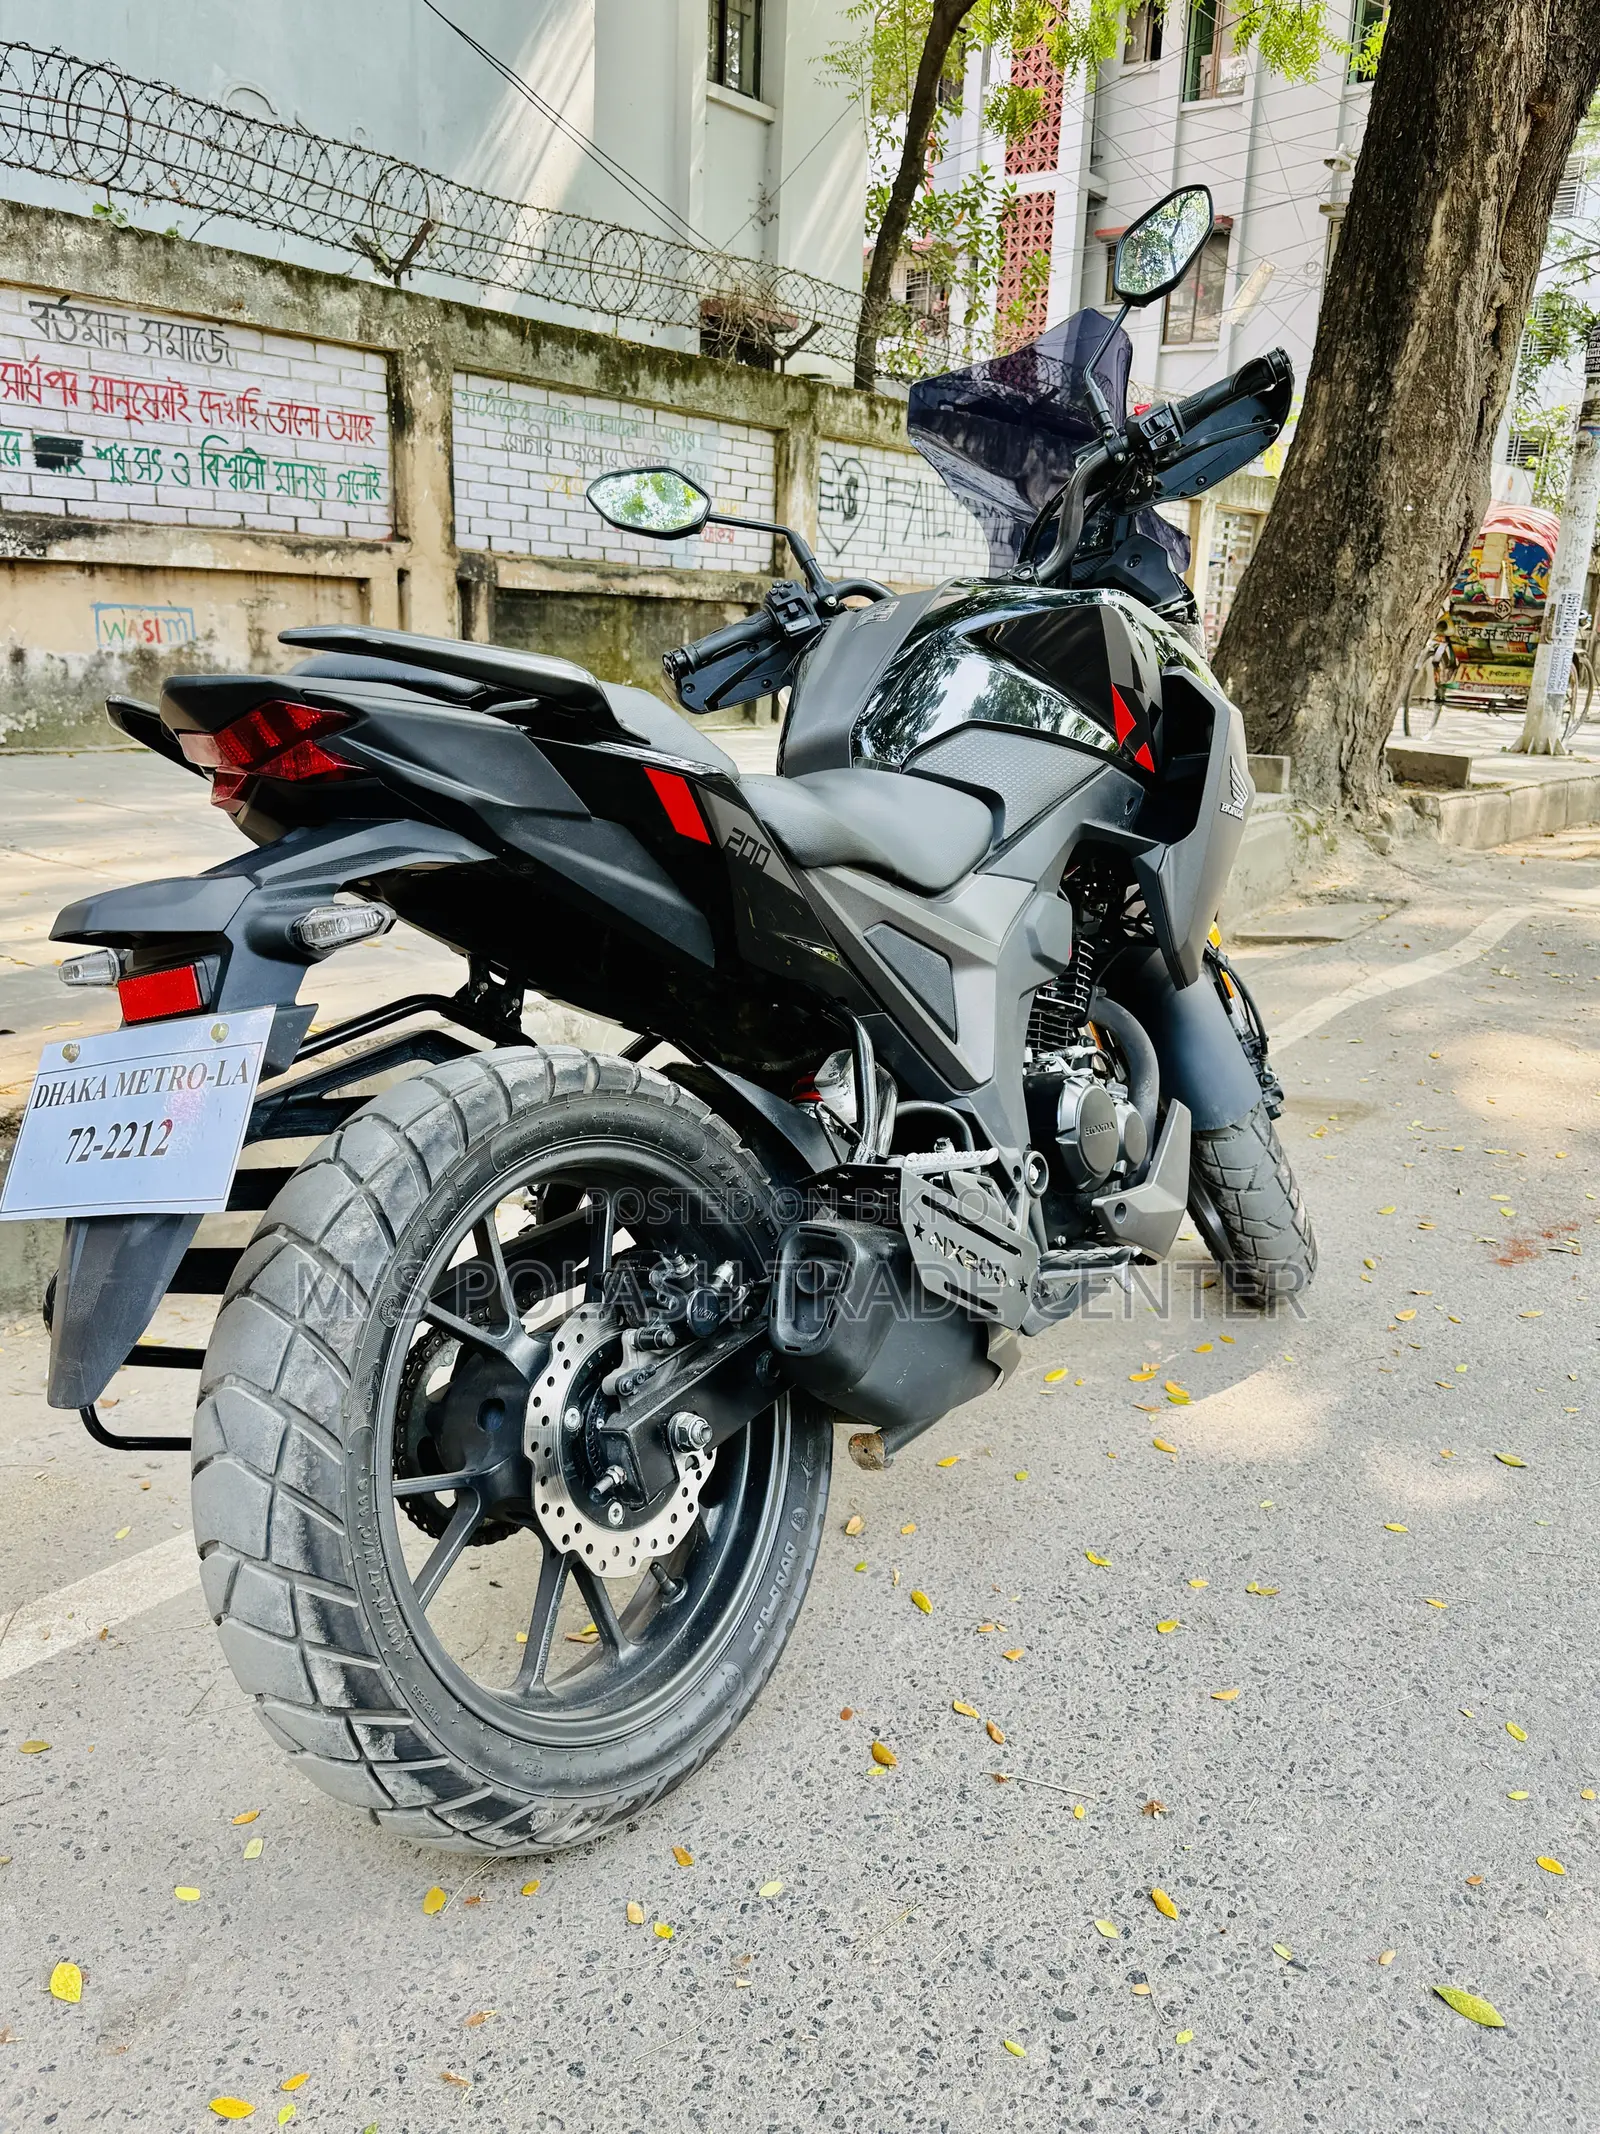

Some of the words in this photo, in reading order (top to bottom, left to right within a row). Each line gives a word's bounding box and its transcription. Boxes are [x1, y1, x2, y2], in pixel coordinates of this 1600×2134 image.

[29, 295, 131, 351] বর্তমান
[139, 317, 232, 367] সমাজে
[89, 376, 192, 425] মানুষেরাই
[267, 401, 320, 439] ভালো
[326, 409, 376, 444] আছে
[132, 447, 163, 483] সৎ
[171, 452, 191, 487] ও
[198, 434, 266, 492] বিশ্বাসী
[724, 826, 772, 873] 200
[32, 1075, 107, 1110] DHAKA
[112, 1057, 249, 1098] METRO-LA
[64, 1119, 174, 1165] 72-2212
[929, 1231, 1007, 1288] NX200
